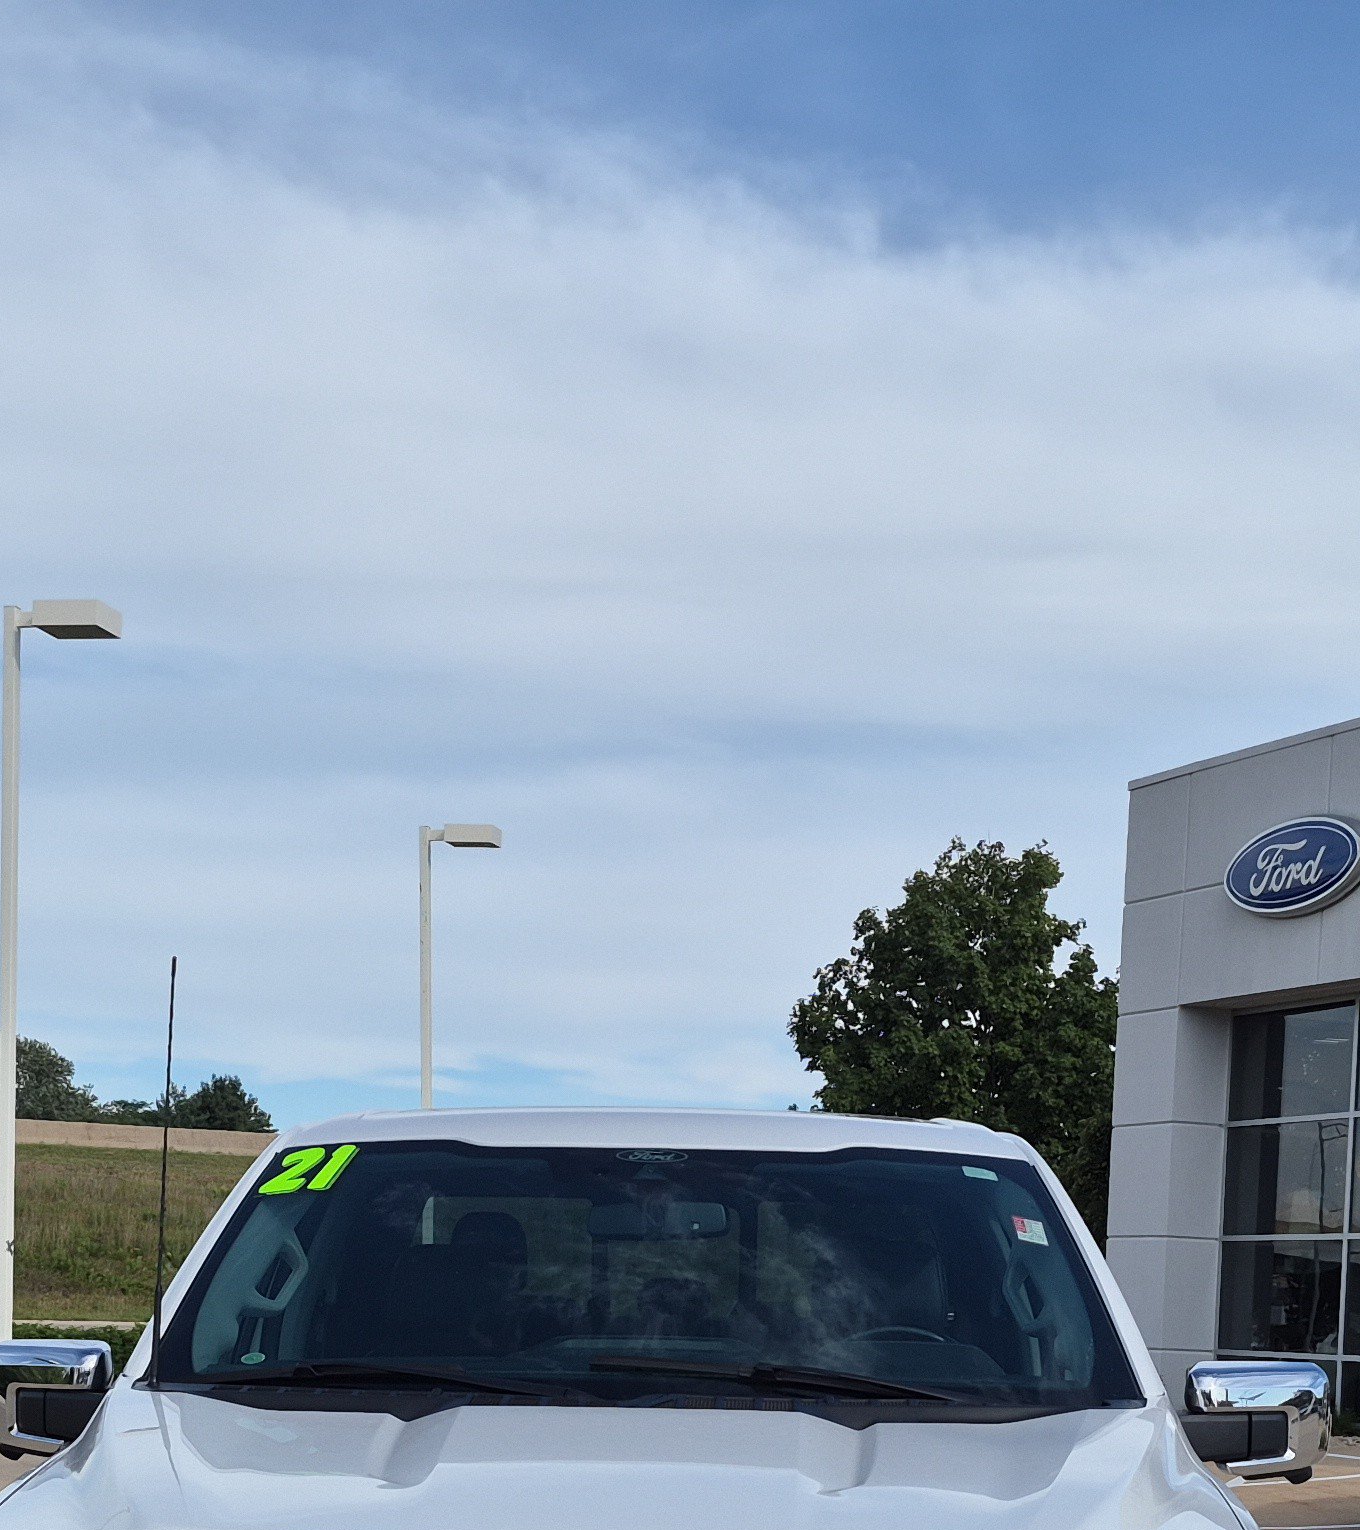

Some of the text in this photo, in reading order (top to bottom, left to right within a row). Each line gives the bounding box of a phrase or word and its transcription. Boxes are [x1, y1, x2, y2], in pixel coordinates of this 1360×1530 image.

[1249, 838, 1327, 897] Ford
[258, 1144, 360, 1195] 21
[628, 1149, 675, 1161] Ford
